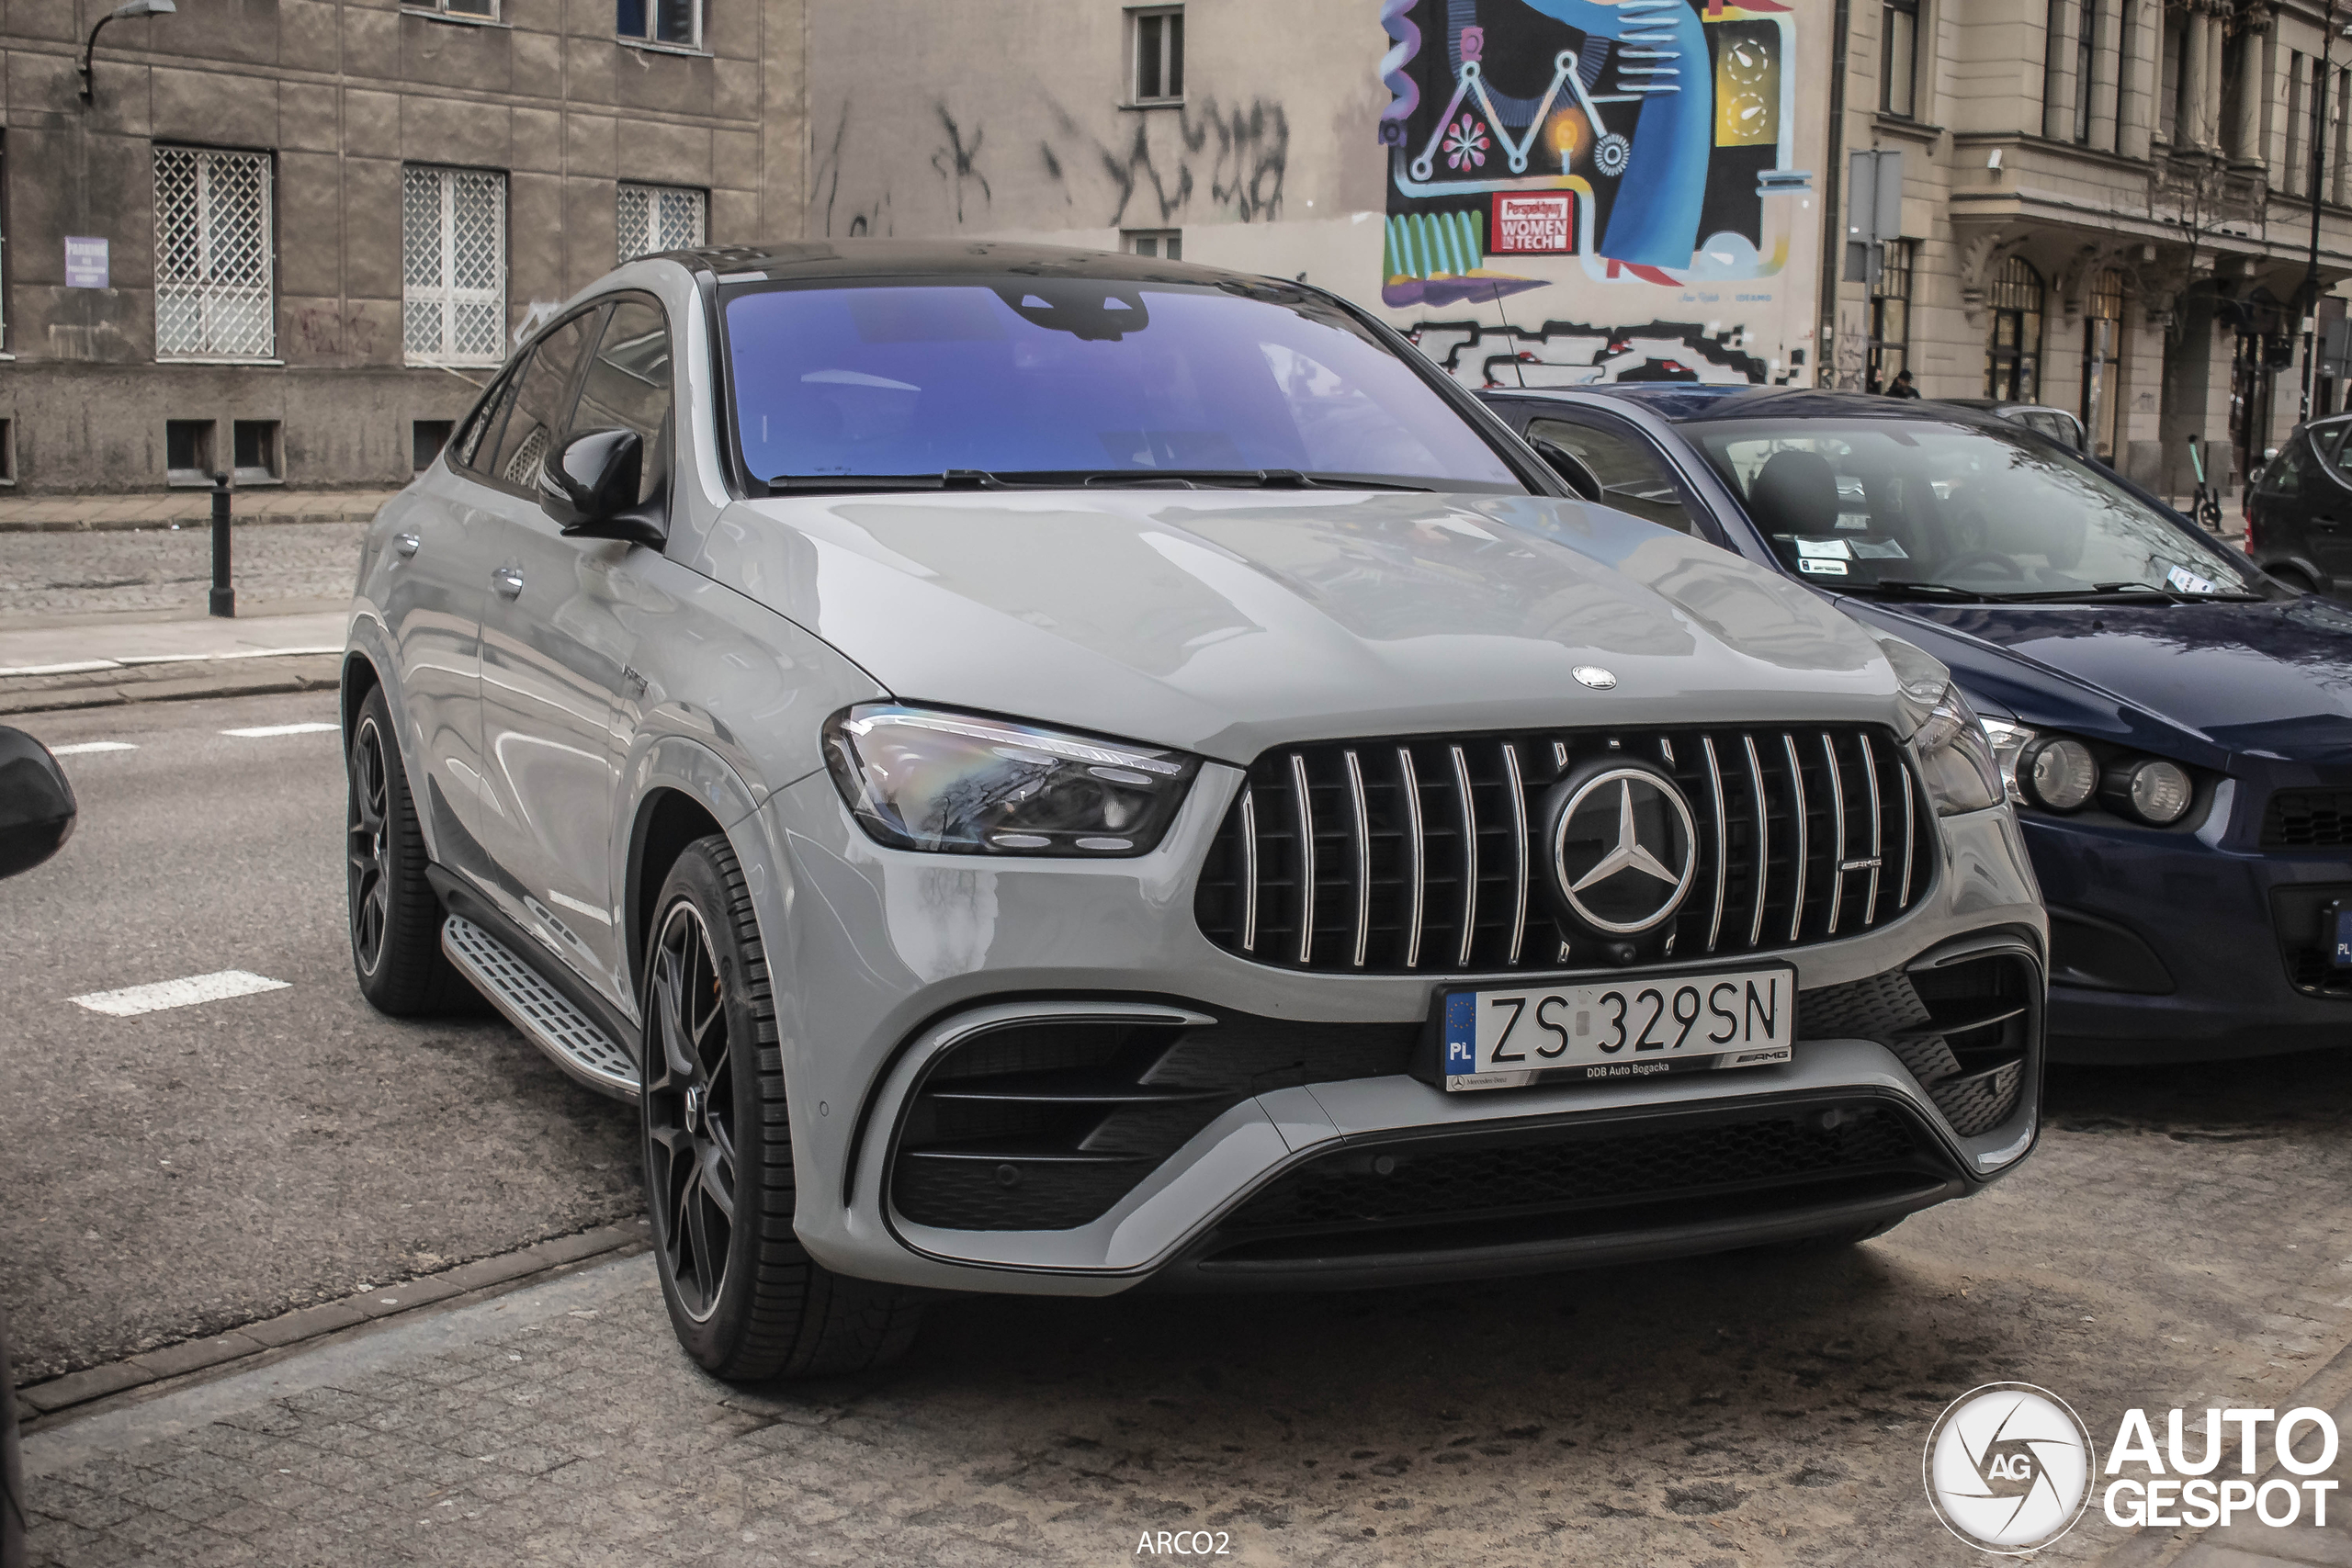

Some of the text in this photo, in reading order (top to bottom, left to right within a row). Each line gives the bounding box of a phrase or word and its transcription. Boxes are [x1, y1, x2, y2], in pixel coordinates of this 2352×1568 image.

[1501, 220, 1566, 236] WOMEN
[1516, 235, 1554, 249] TECH
[2337, 942, 2350, 955] PL
[1490, 977, 1777, 1064] ZS 329SN
[1450, 1042, 1472, 1061] PL
[1754, 1051, 1789, 1061] AMG
[1587, 1063, 1669, 1077] DDB Auto Bogacka
[1467, 1077, 1508, 1086] Mercedes-Benz
